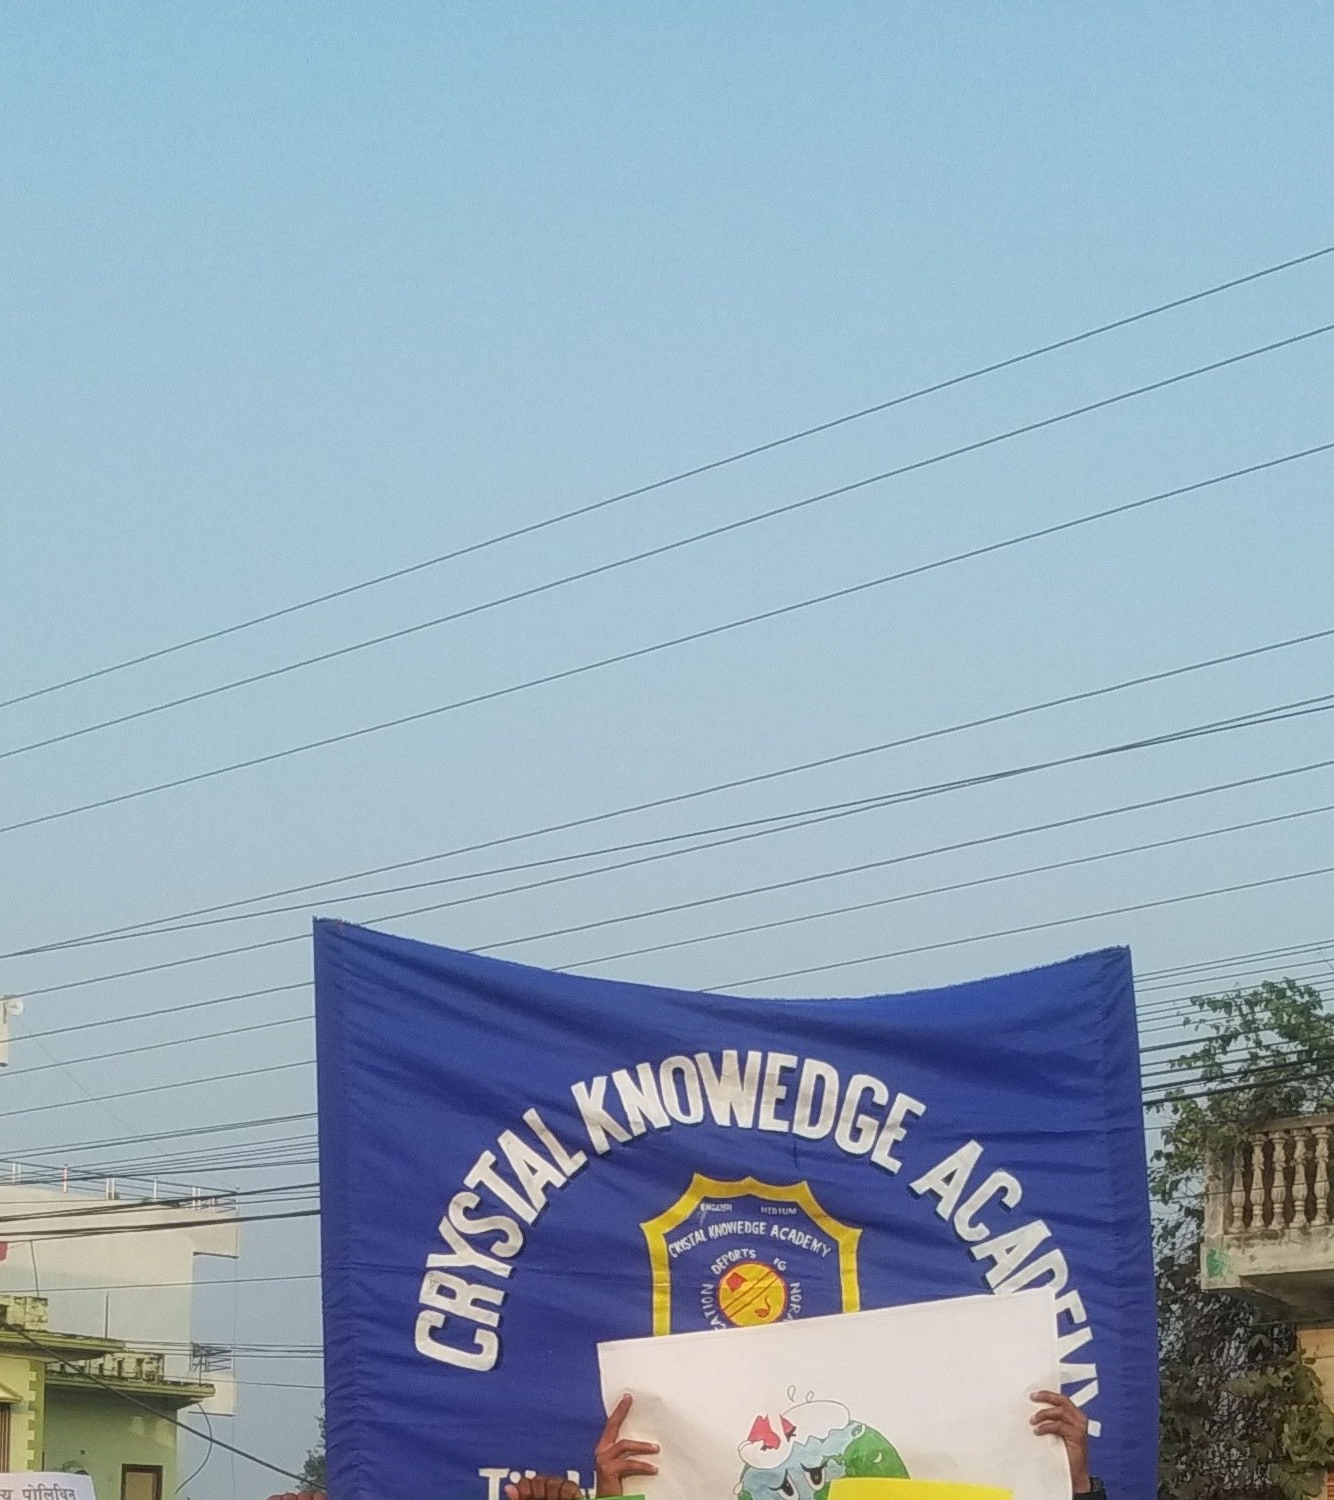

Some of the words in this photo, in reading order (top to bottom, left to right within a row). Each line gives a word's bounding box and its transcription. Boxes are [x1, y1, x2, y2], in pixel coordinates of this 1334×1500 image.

[413, 1105, 590, 1372] CRYSTAL
[569, 1049, 927, 1176] KNOWEDGE
[910, 1139, 1102, 1440] ACAD
[708, 1220, 767, 1240] KNOWEDGE
[770, 1224, 832, 1259] ACADEMY
